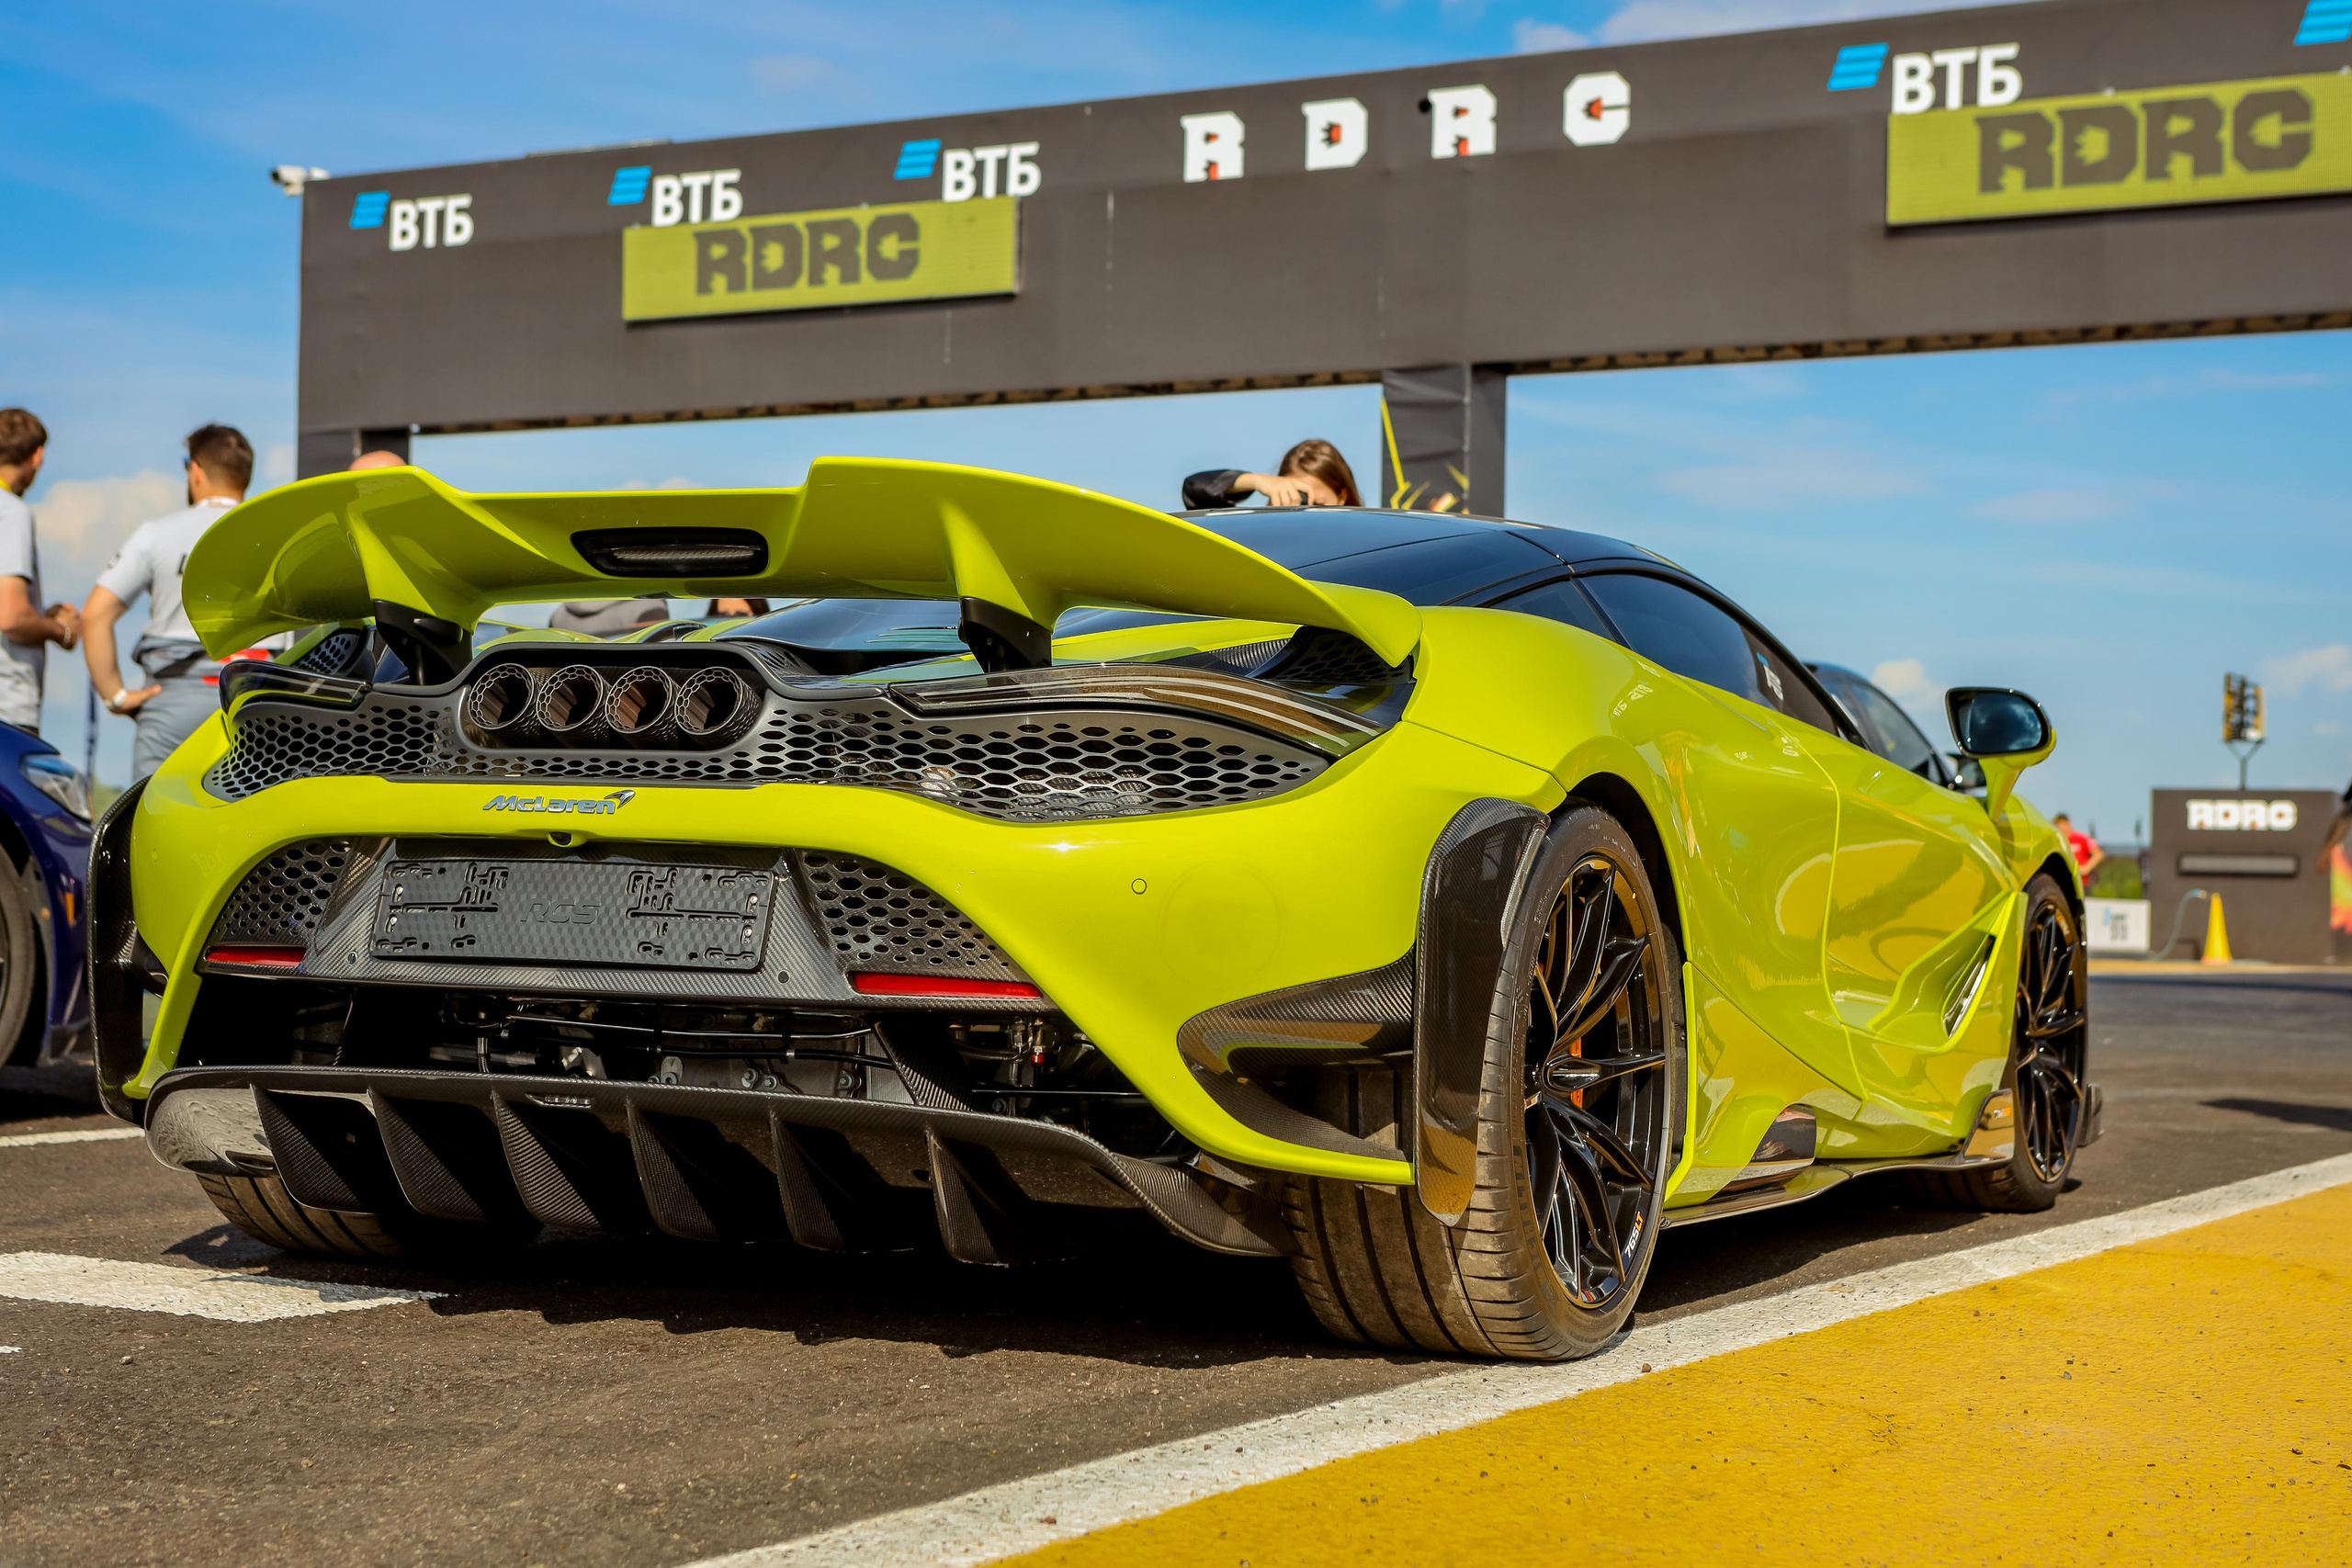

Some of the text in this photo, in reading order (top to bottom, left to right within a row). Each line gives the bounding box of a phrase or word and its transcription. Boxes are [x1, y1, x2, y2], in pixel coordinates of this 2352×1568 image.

[1892, 44, 2021, 115] ВТБ
[1973, 87, 2313, 195] RDRC
[651, 170, 742, 228] ВТБ
[942, 142, 1042, 203] ВТБ
[390, 195, 474, 251] ВТБ
[695, 213, 921, 295] RDRC
[482, 795, 616, 815] McLaren
[2187, 800, 2296, 830] RDRC
[520, 897, 602, 925] RCS
[1624, 1211, 1644, 1259] 765LT
